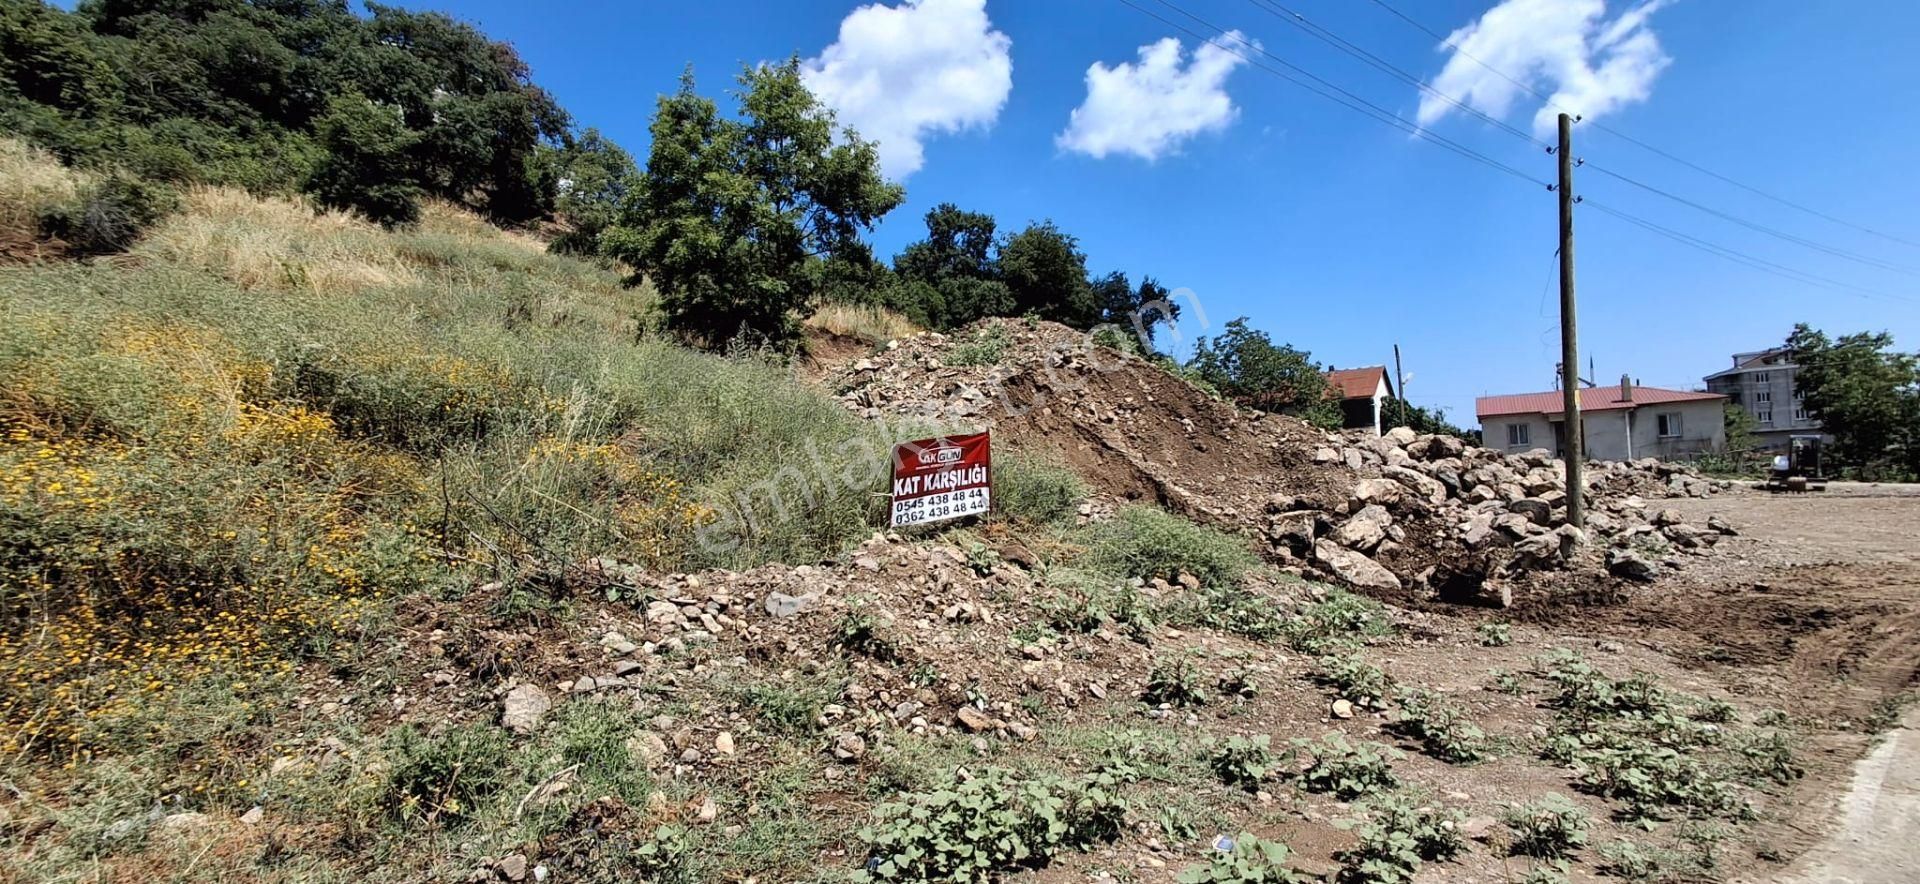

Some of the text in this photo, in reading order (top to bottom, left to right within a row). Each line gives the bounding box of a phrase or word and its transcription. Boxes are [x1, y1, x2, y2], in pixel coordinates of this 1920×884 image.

[895, 476, 921, 496] KAT
[924, 463, 987, 492] KARŞILIĞI
[895, 500, 984, 525] 0362 438 48 44
[896, 488, 983, 513] 0545 438 48 44
